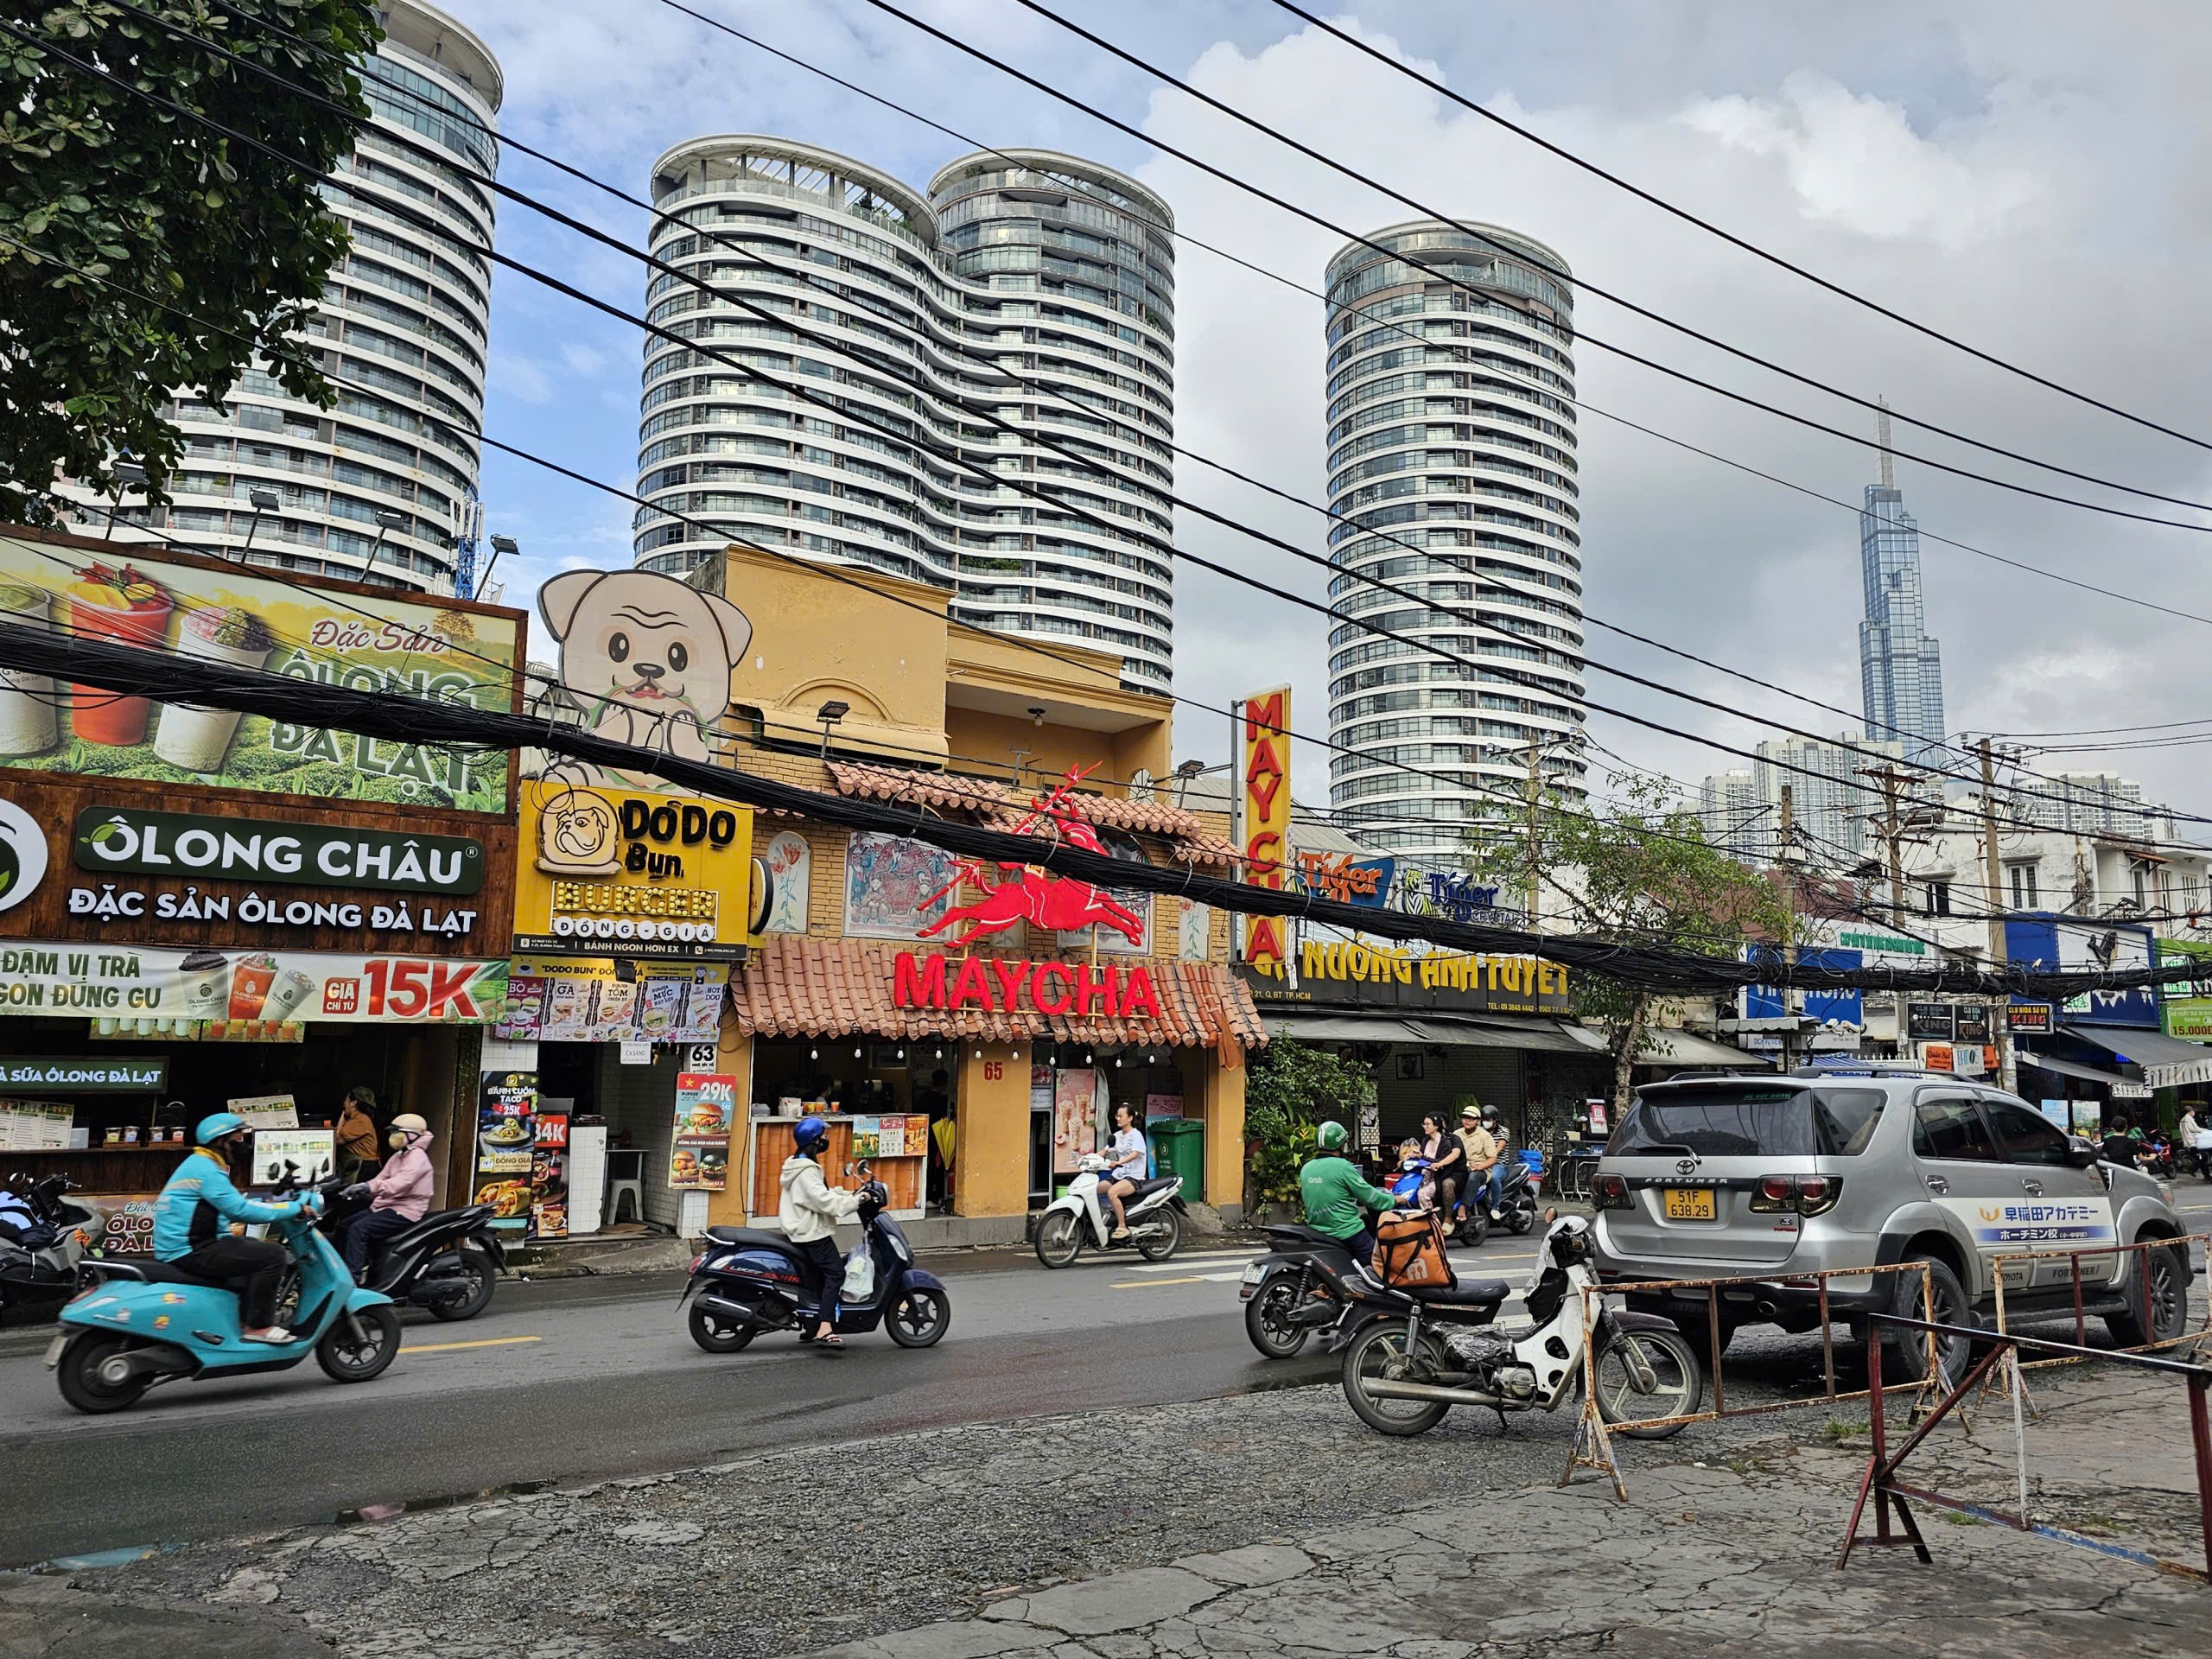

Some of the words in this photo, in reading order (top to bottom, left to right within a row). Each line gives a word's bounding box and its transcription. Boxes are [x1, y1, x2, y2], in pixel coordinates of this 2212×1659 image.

[311, 620, 370, 652] Đặc
[374, 622, 446, 652] Sản
[92, 815, 302, 873] ÔLONG
[318, 840, 461, 885] CHÂU
[1298, 851, 1383, 905] Tiger
[557, 881, 714, 917] BURGER
[1427, 871, 1499, 922] Tiger
[69, 884, 145, 923] ĐẶC
[156, 887, 229, 922] SẢN
[238, 891, 361, 927] ÔLONG
[371, 899, 414, 931] ĐÀ
[423, 909, 477, 939] LẠT
[584, 942, 612, 950] BÁNH
[614, 943, 644, 952] NGON
[645, 944, 666, 953] HƠN
[0, 948, 59, 978] ĐẬM
[68, 953, 90, 981] VỊ
[98, 951, 142, 978] TRÀ
[1302, 932, 1413, 984] NƯỚNG
[327, 979, 357, 1000] GIÁ
[363, 959, 486, 1019] 15K
[557, 983, 575, 995] GÀ
[893, 951, 1160, 1018] MAYCHA
[51, 981, 120, 1008] ĐÚNG
[127, 987, 162, 1009] GU
[327, 1001, 340, 1011] CHỈ
[1914, 1020, 1951, 1033] KING
[2011, 1014, 2046, 1024] KING
[1958, 1024, 1983, 1039] KING
[692, 1045, 715, 1062] 63
[10, 1066, 44, 1082] SỮA
[45, 1066, 106, 1083] ÔLONG
[109, 1067, 131, 1083] ĐÀ
[132, 1070, 162, 1085] LẠT
[983, 1061, 1003, 1081] 65
[700, 1081, 733, 1102] 29K
[503, 1105, 521, 1116] 25K
[1678, 1191, 1699, 1203] 51F
[1670, 1205, 1710, 1217] 638.29
[2005, 1206, 2098, 1221] 早稲田アカデミー
[107, 1213, 154, 1233] ÔLO
[102, 1231, 140, 1253] ĐÀ
[2000, 1228, 2058, 1241] ホーチミン校
[2052, 1266, 2095, 1278] FORTNER
